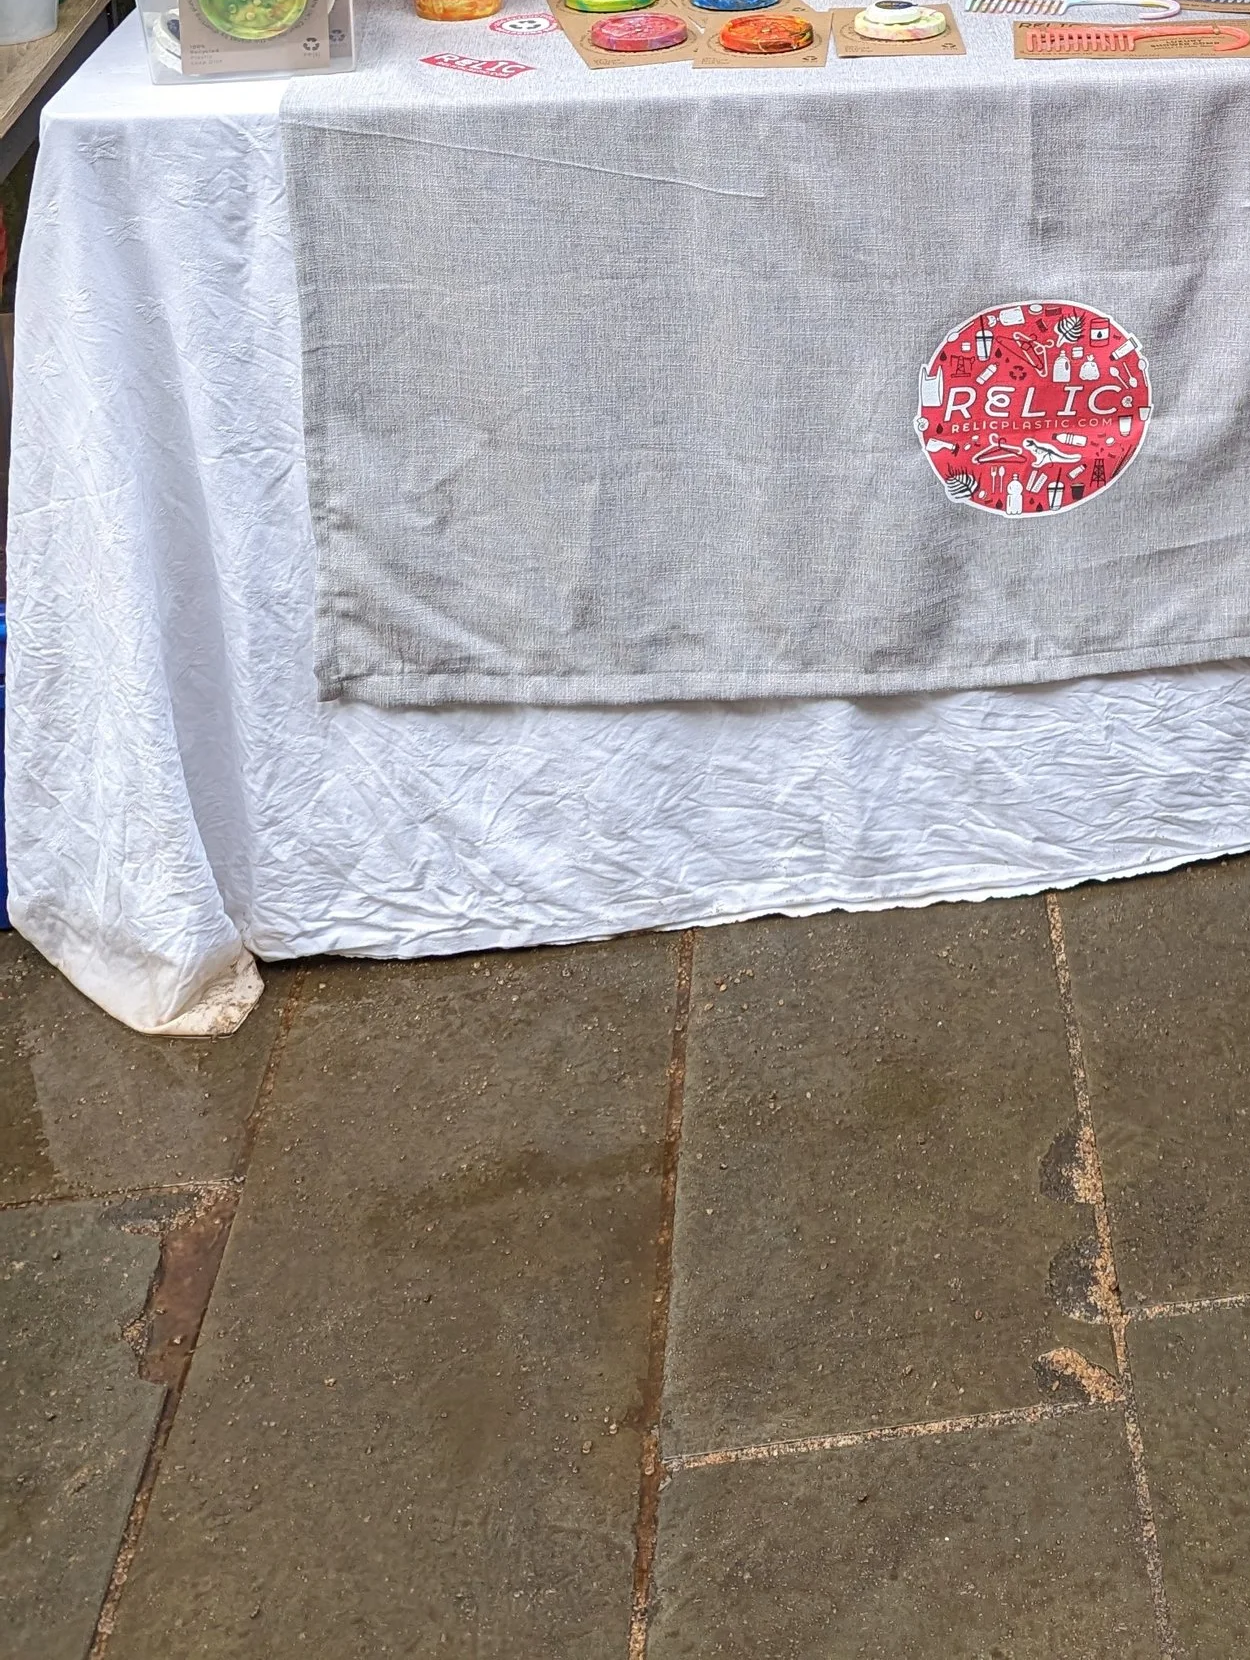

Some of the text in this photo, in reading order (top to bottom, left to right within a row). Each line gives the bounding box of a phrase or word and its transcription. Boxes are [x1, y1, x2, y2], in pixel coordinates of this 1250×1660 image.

[434, 54, 521, 74] RELIC
[944, 385, 1122, 423] RELIC
[951, 418, 1113, 434] RELICPLASTIC.COM
